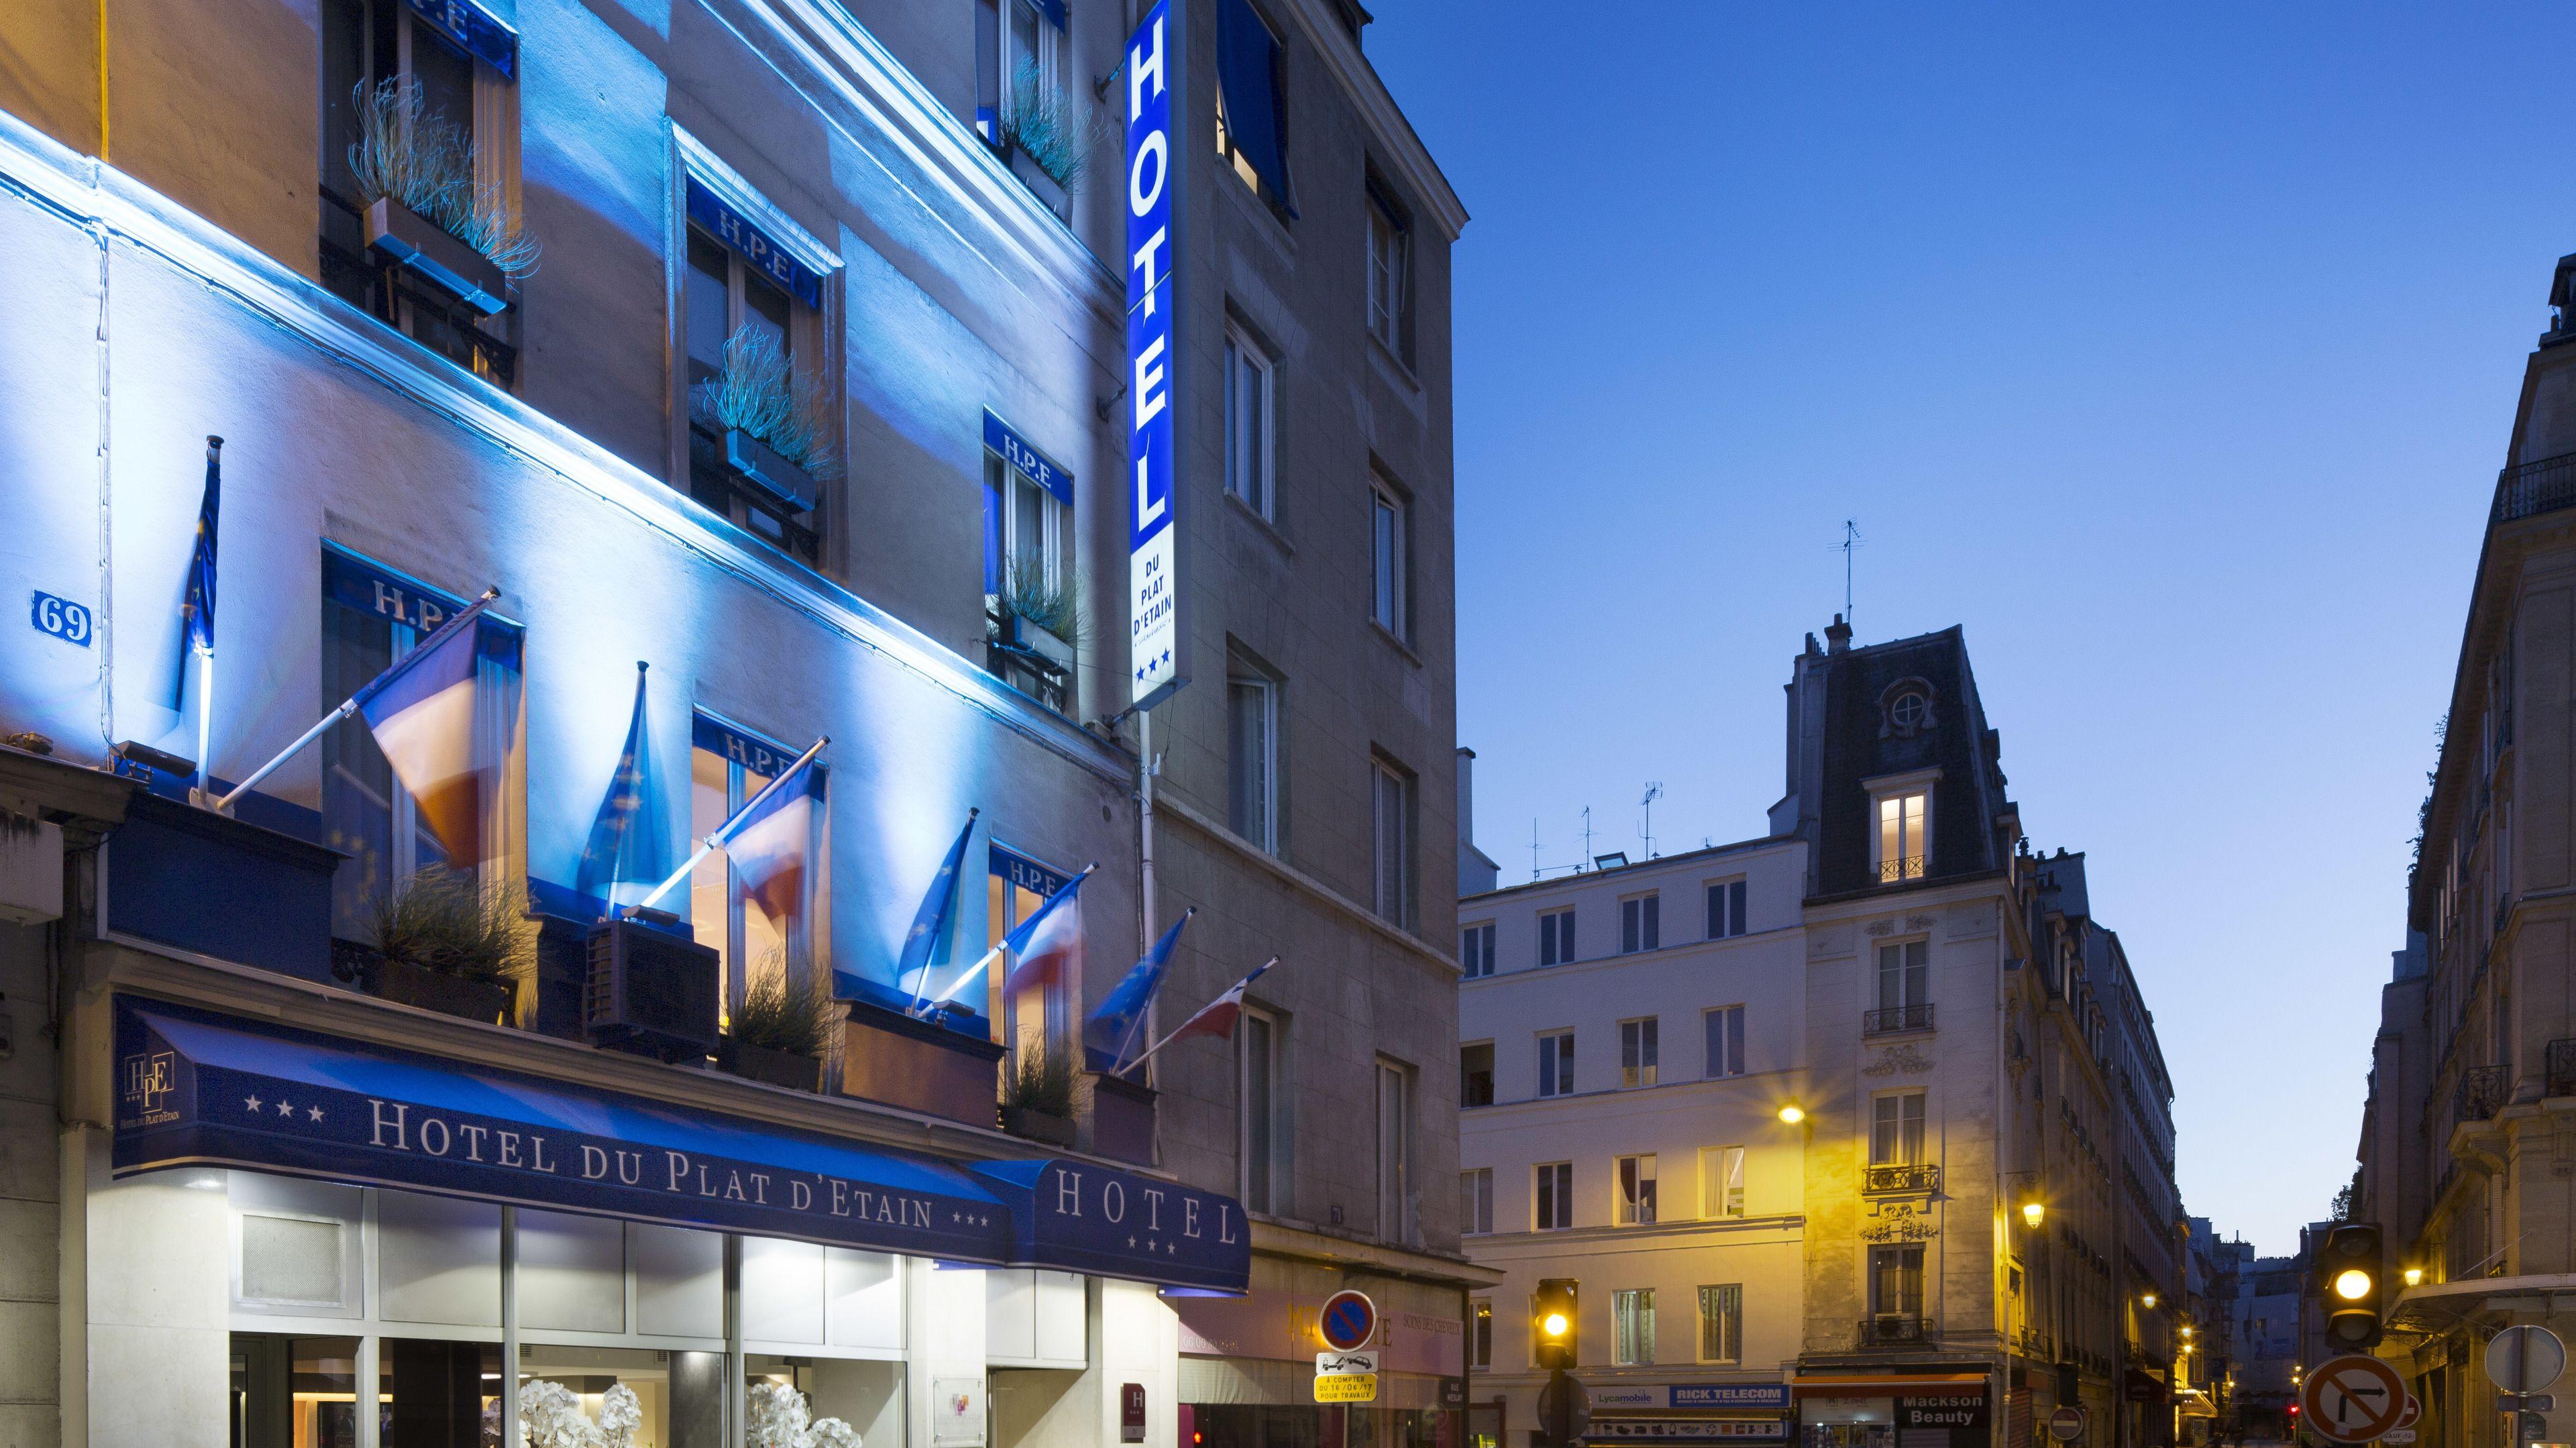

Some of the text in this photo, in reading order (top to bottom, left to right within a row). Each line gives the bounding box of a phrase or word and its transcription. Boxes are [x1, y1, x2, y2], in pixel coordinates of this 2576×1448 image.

[719, 209, 790, 283] H.P.E
[1130, 11, 1167, 535] HOTEL
[1004, 434, 1051, 489] H.P.E
[1146, 553, 1159, 577] DU
[1141, 574, 1164, 606] PLAT
[39, 597, 88, 641] 69
[1134, 594, 1171, 636] D'ETAIN
[1010, 860, 1057, 897] H.P.E
[146, 1115, 159, 1125] PLAT
[580, 1144, 642, 1185] DU
[1056, 1168, 1236, 1245] HOTEL
[1133, 1392, 1143, 1407] H
[1598, 1392, 1652, 1404] Lycamobile
[1677, 1388, 1782, 1400] RICK TELECOM
[1903, 1396, 1982, 1407] Mackson
[1911, 1410, 1974, 1425] Beauty
